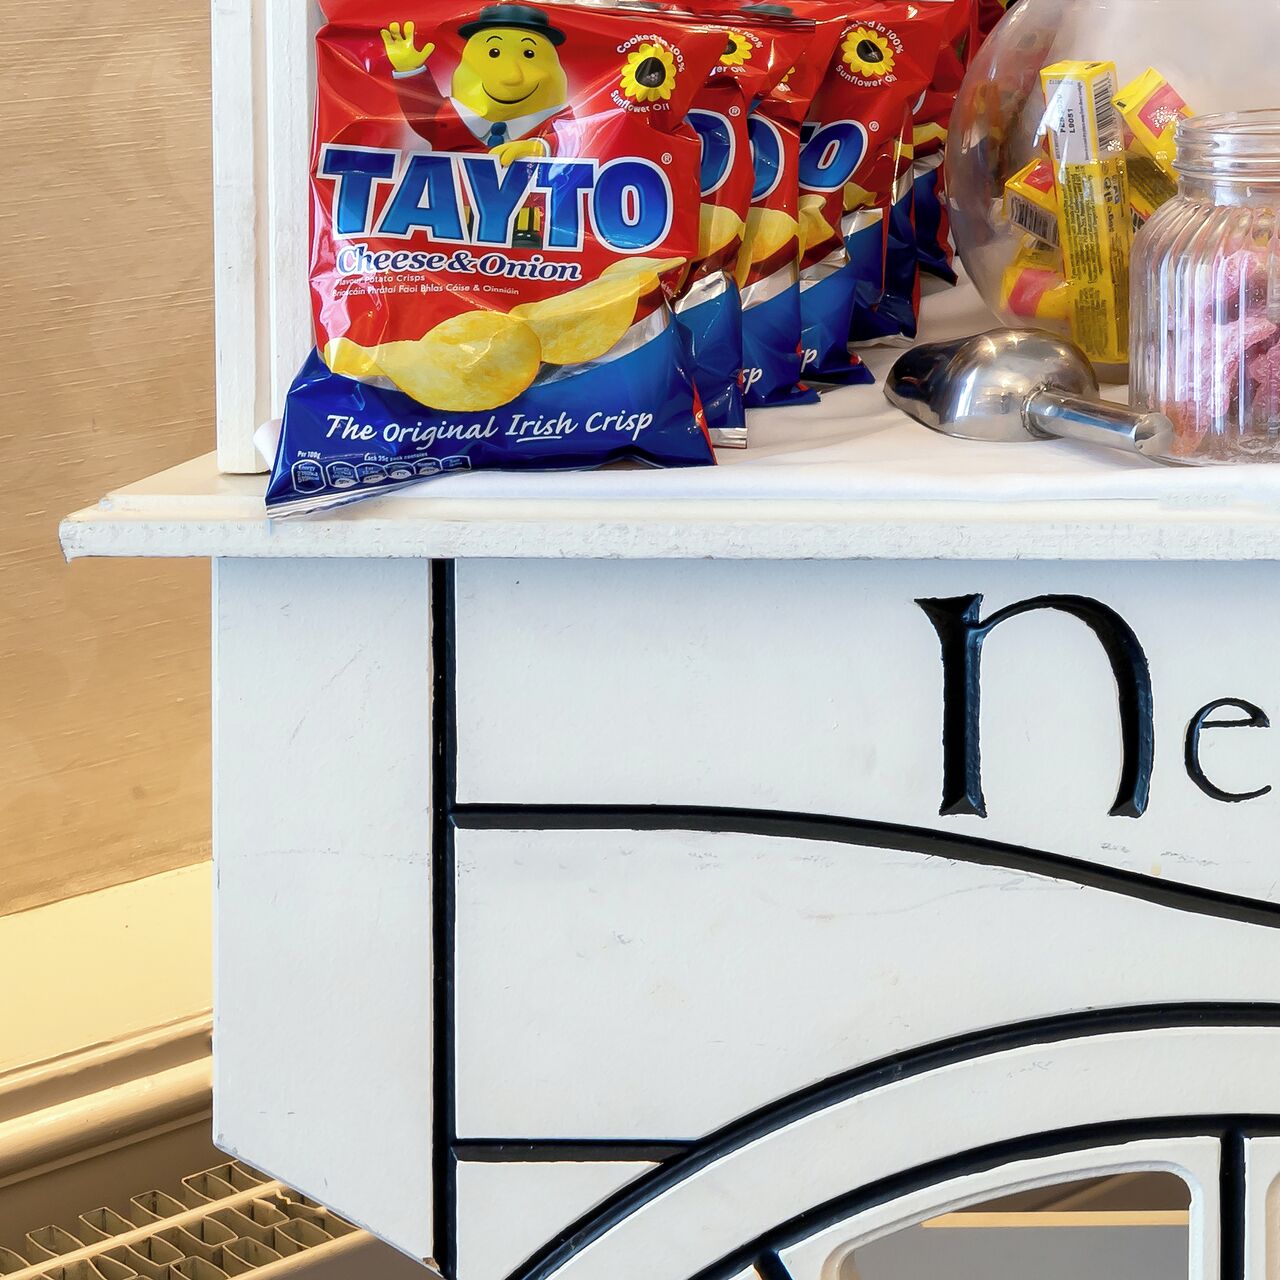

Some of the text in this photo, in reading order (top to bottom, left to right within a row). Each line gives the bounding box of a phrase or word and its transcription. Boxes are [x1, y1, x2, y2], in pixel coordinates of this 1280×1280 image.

[616, 34, 658, 54] Cooked
[669, 44, 686, 73] 100%
[876, 22, 886, 33] in
[886, 29, 904, 54] 100%
[835, 64, 882, 88] Sunflower
[610, 89, 670, 113] Sunflower Oil
[316, 142, 674, 255] TAYTO
[364, 275, 394, 283] Potato
[396, 274, 426, 283] Crisps
[326, 410, 654, 452] The Original Irish Crisp
